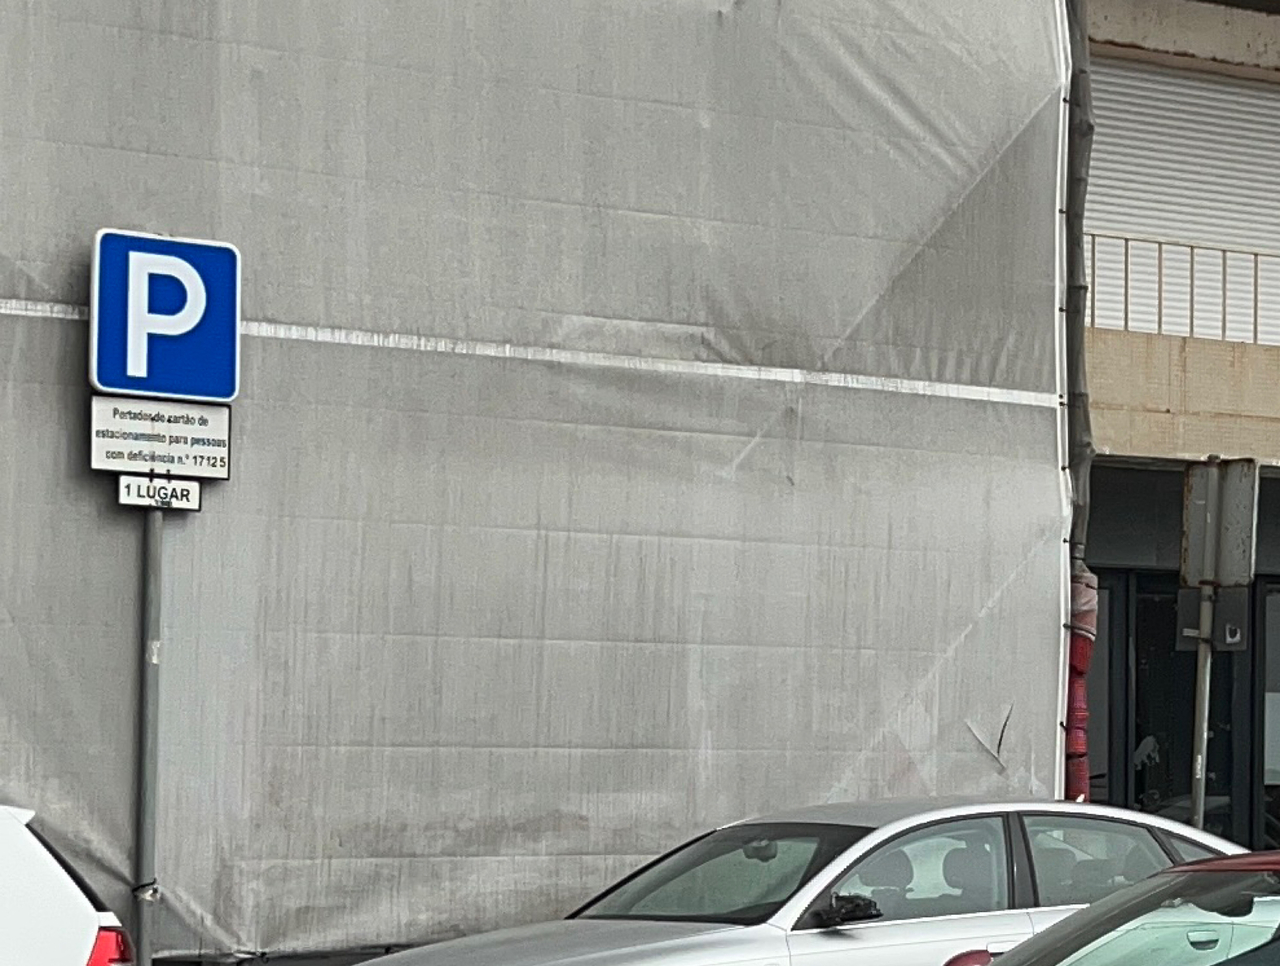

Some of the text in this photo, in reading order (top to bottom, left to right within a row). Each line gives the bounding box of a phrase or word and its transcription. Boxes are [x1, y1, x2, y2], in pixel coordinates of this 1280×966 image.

[127, 250, 207, 378] P
[169, 435, 189, 446] para
[190, 436, 227, 448] pessoas
[105, 450, 125, 460] com
[192, 454, 226, 468] 17125
[124, 483, 191, 503] 1 LUGAR
